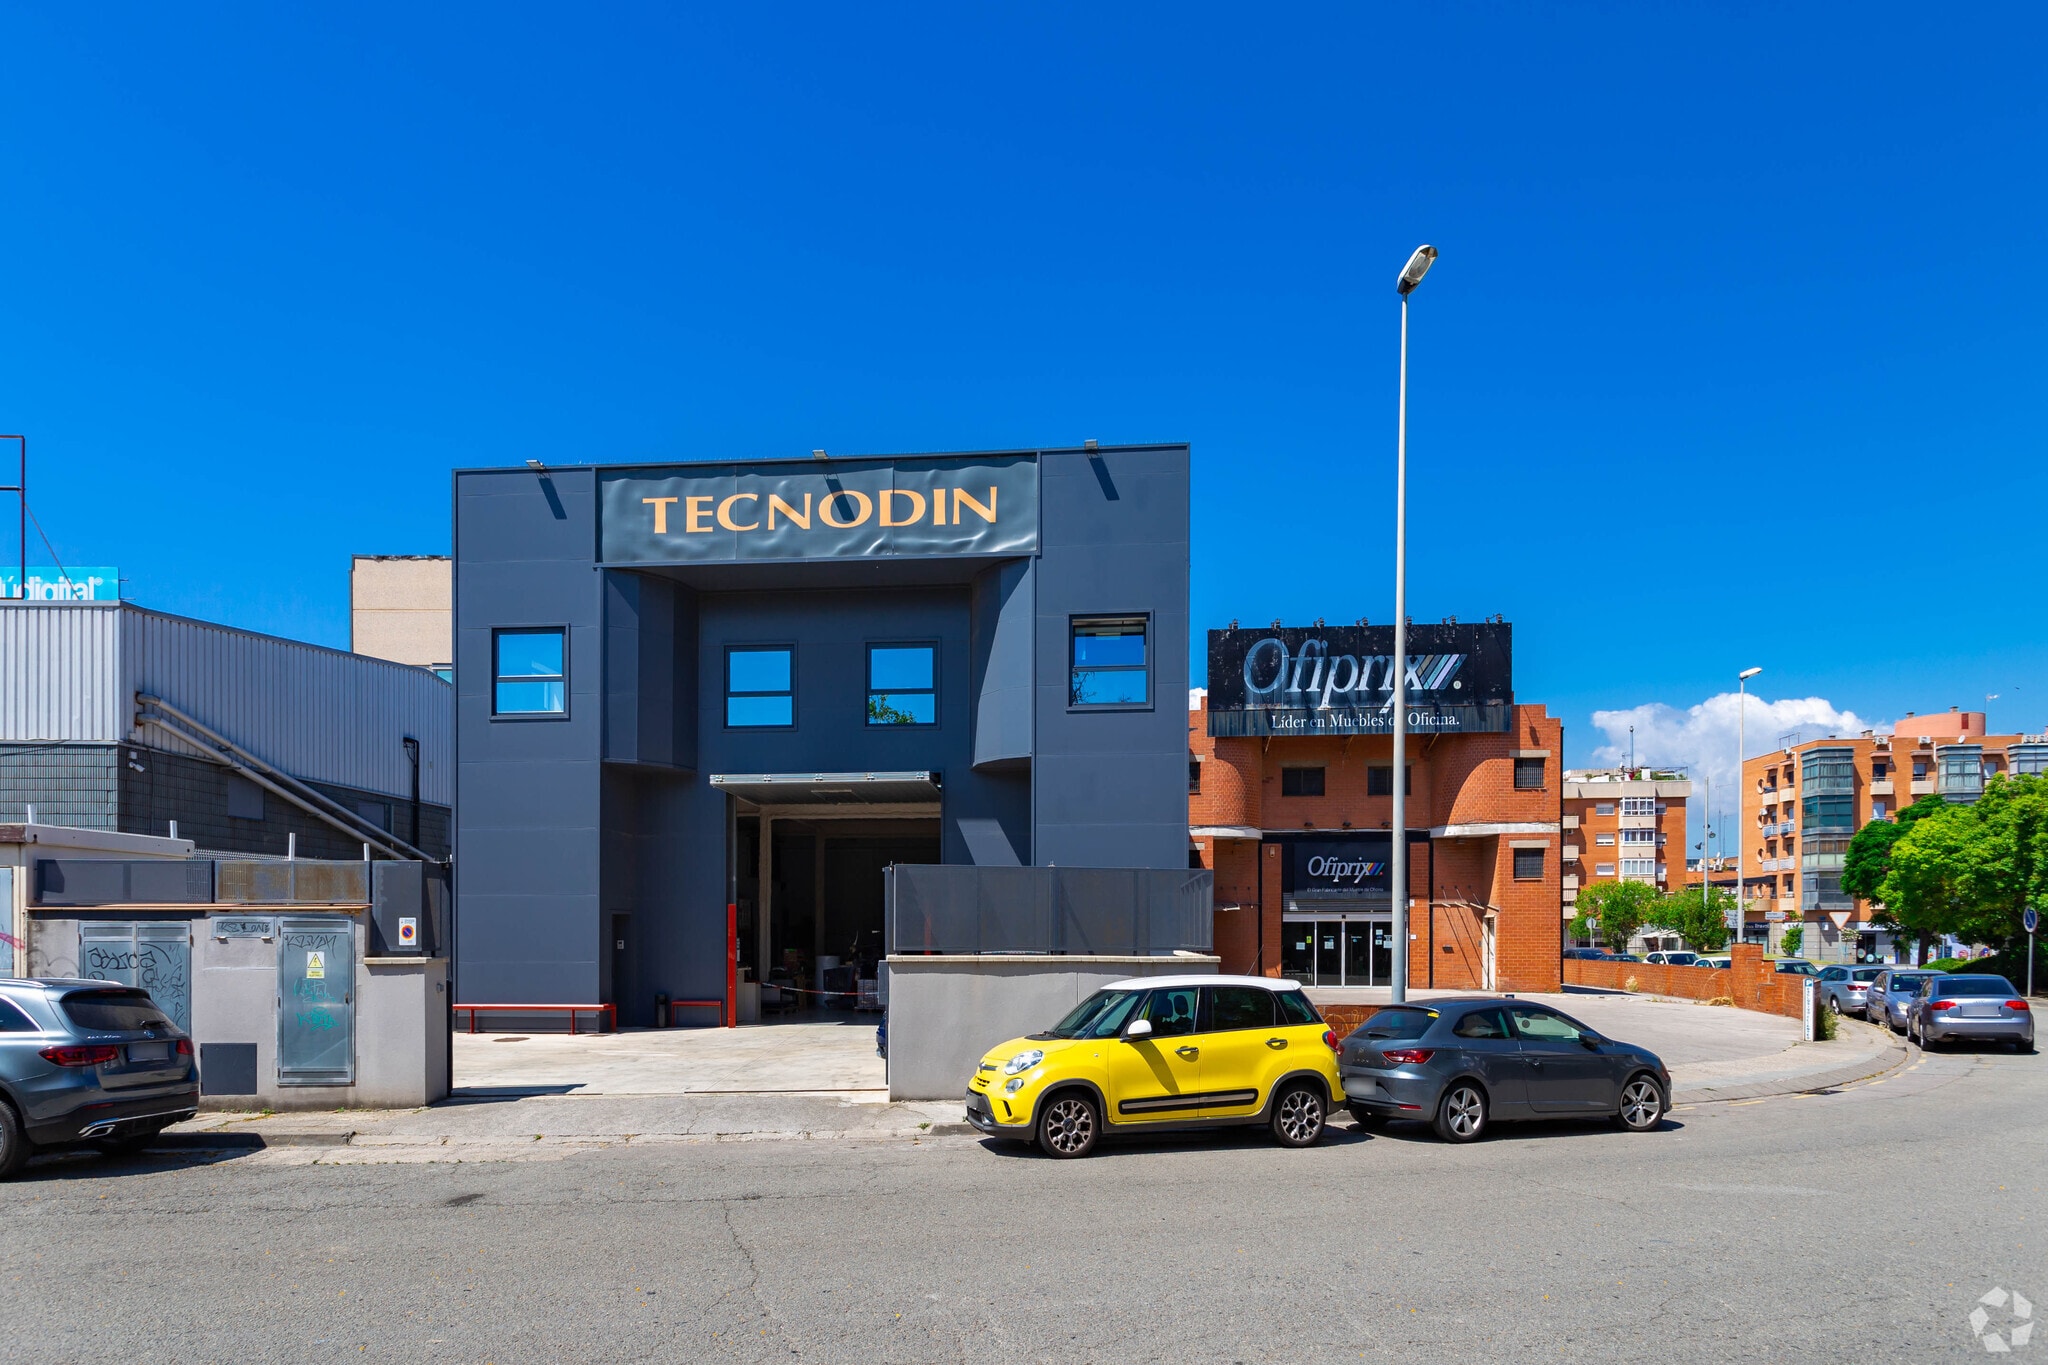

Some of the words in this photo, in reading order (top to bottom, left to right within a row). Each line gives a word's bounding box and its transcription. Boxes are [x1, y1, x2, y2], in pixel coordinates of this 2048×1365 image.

[642, 486, 997, 534] TECNODIN
[1243, 637, 1427, 713] Ofiprix
[1272, 714, 1306, 728] Líder
[1310, 718, 1325, 728] en
[1330, 713, 1384, 728] Muebles
[1408, 711, 1460, 726] Oficina.
[1308, 856, 1370, 883] Ofiprix
